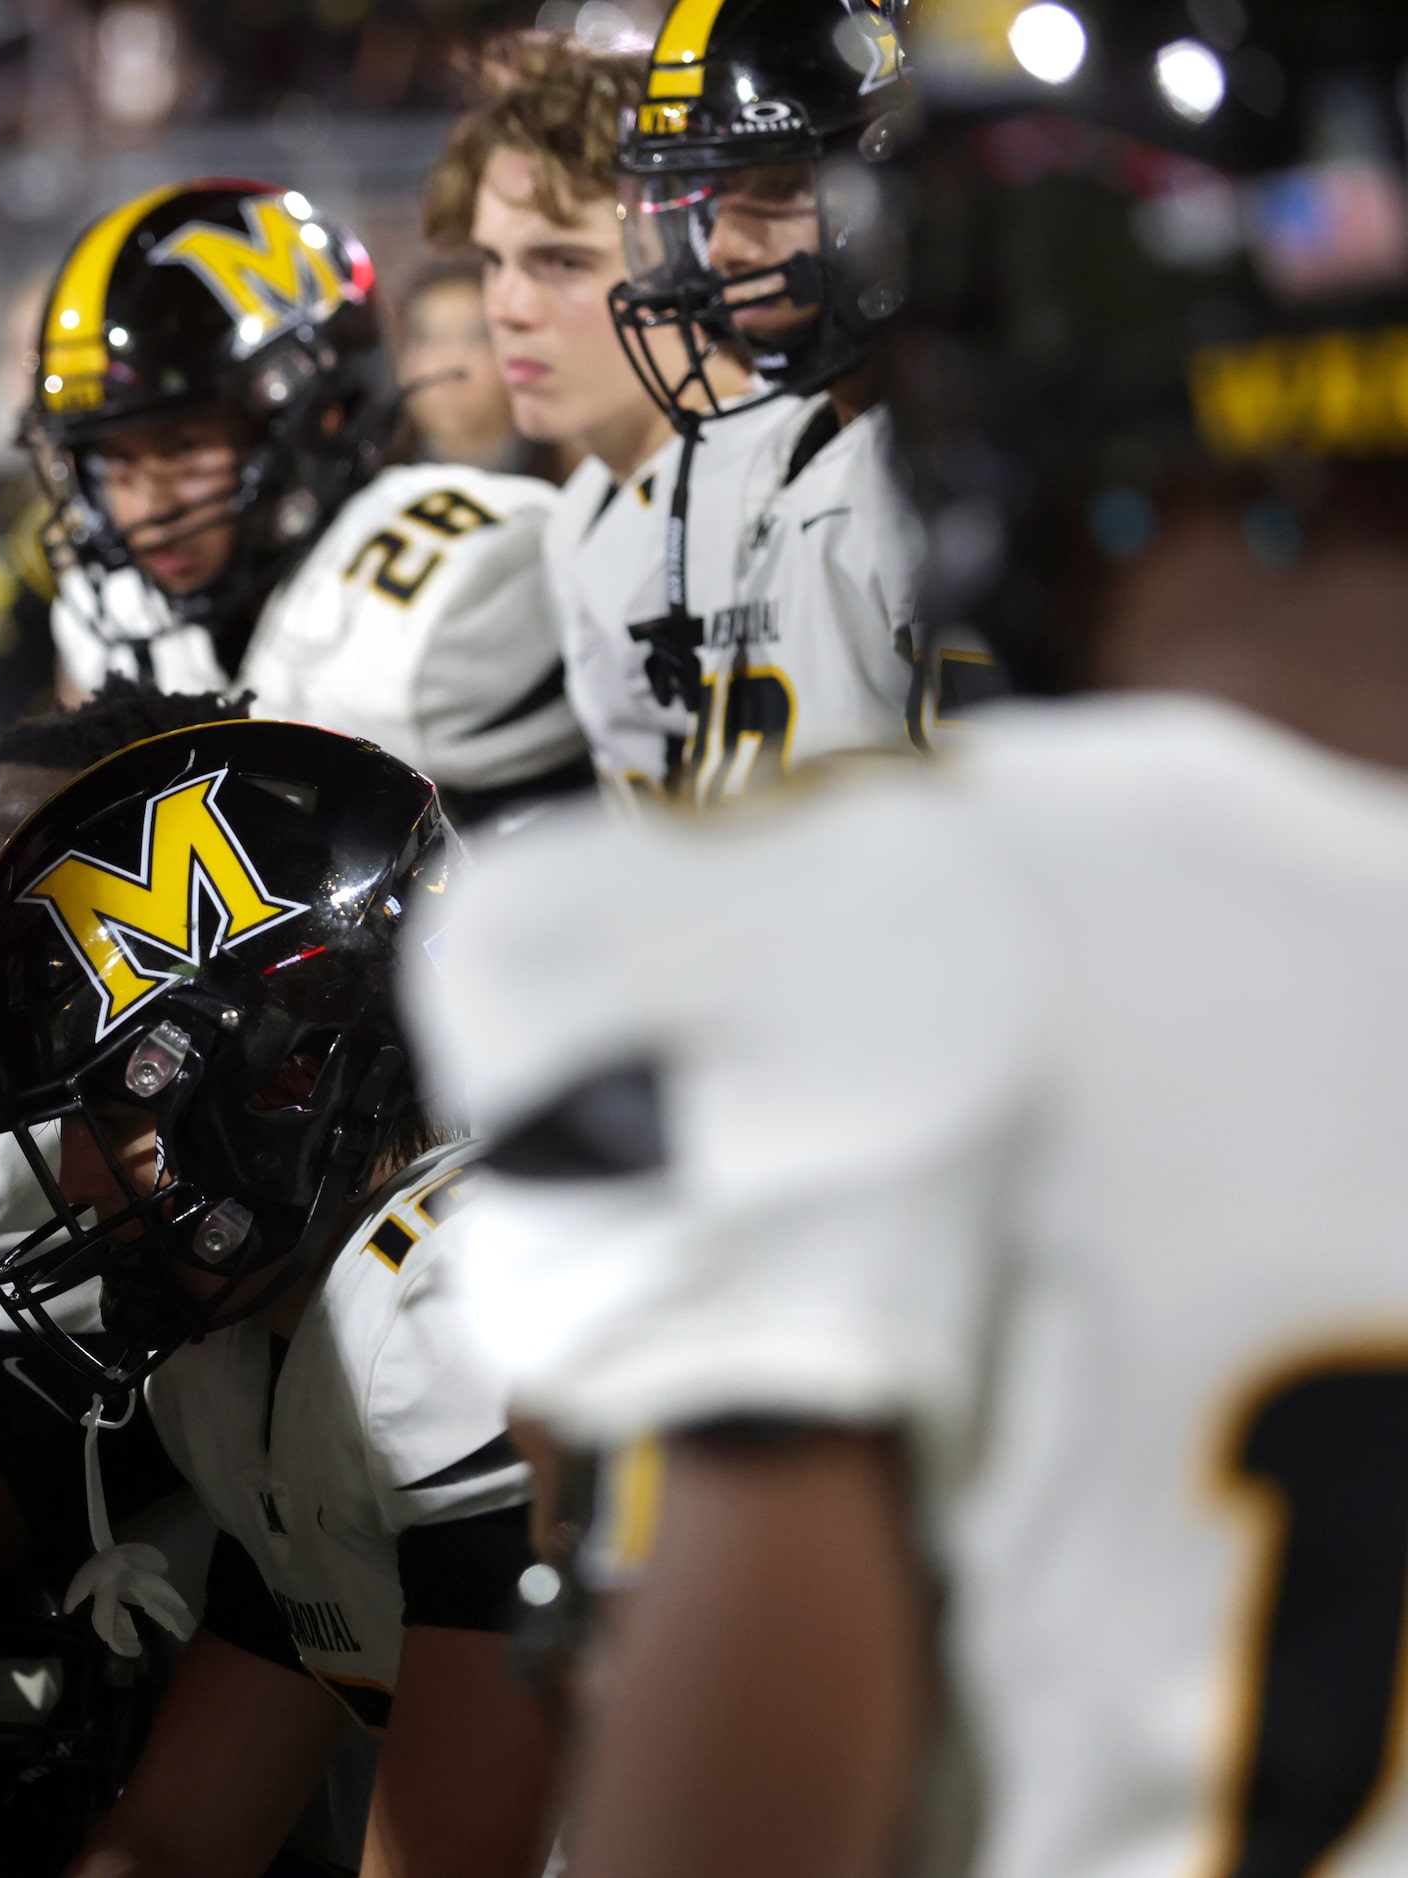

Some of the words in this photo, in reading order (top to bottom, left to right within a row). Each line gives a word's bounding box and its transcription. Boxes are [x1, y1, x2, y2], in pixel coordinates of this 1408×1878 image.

[147, 192, 350, 361] M
[343, 490, 501, 608] 28
[14, 767, 311, 1044] M
